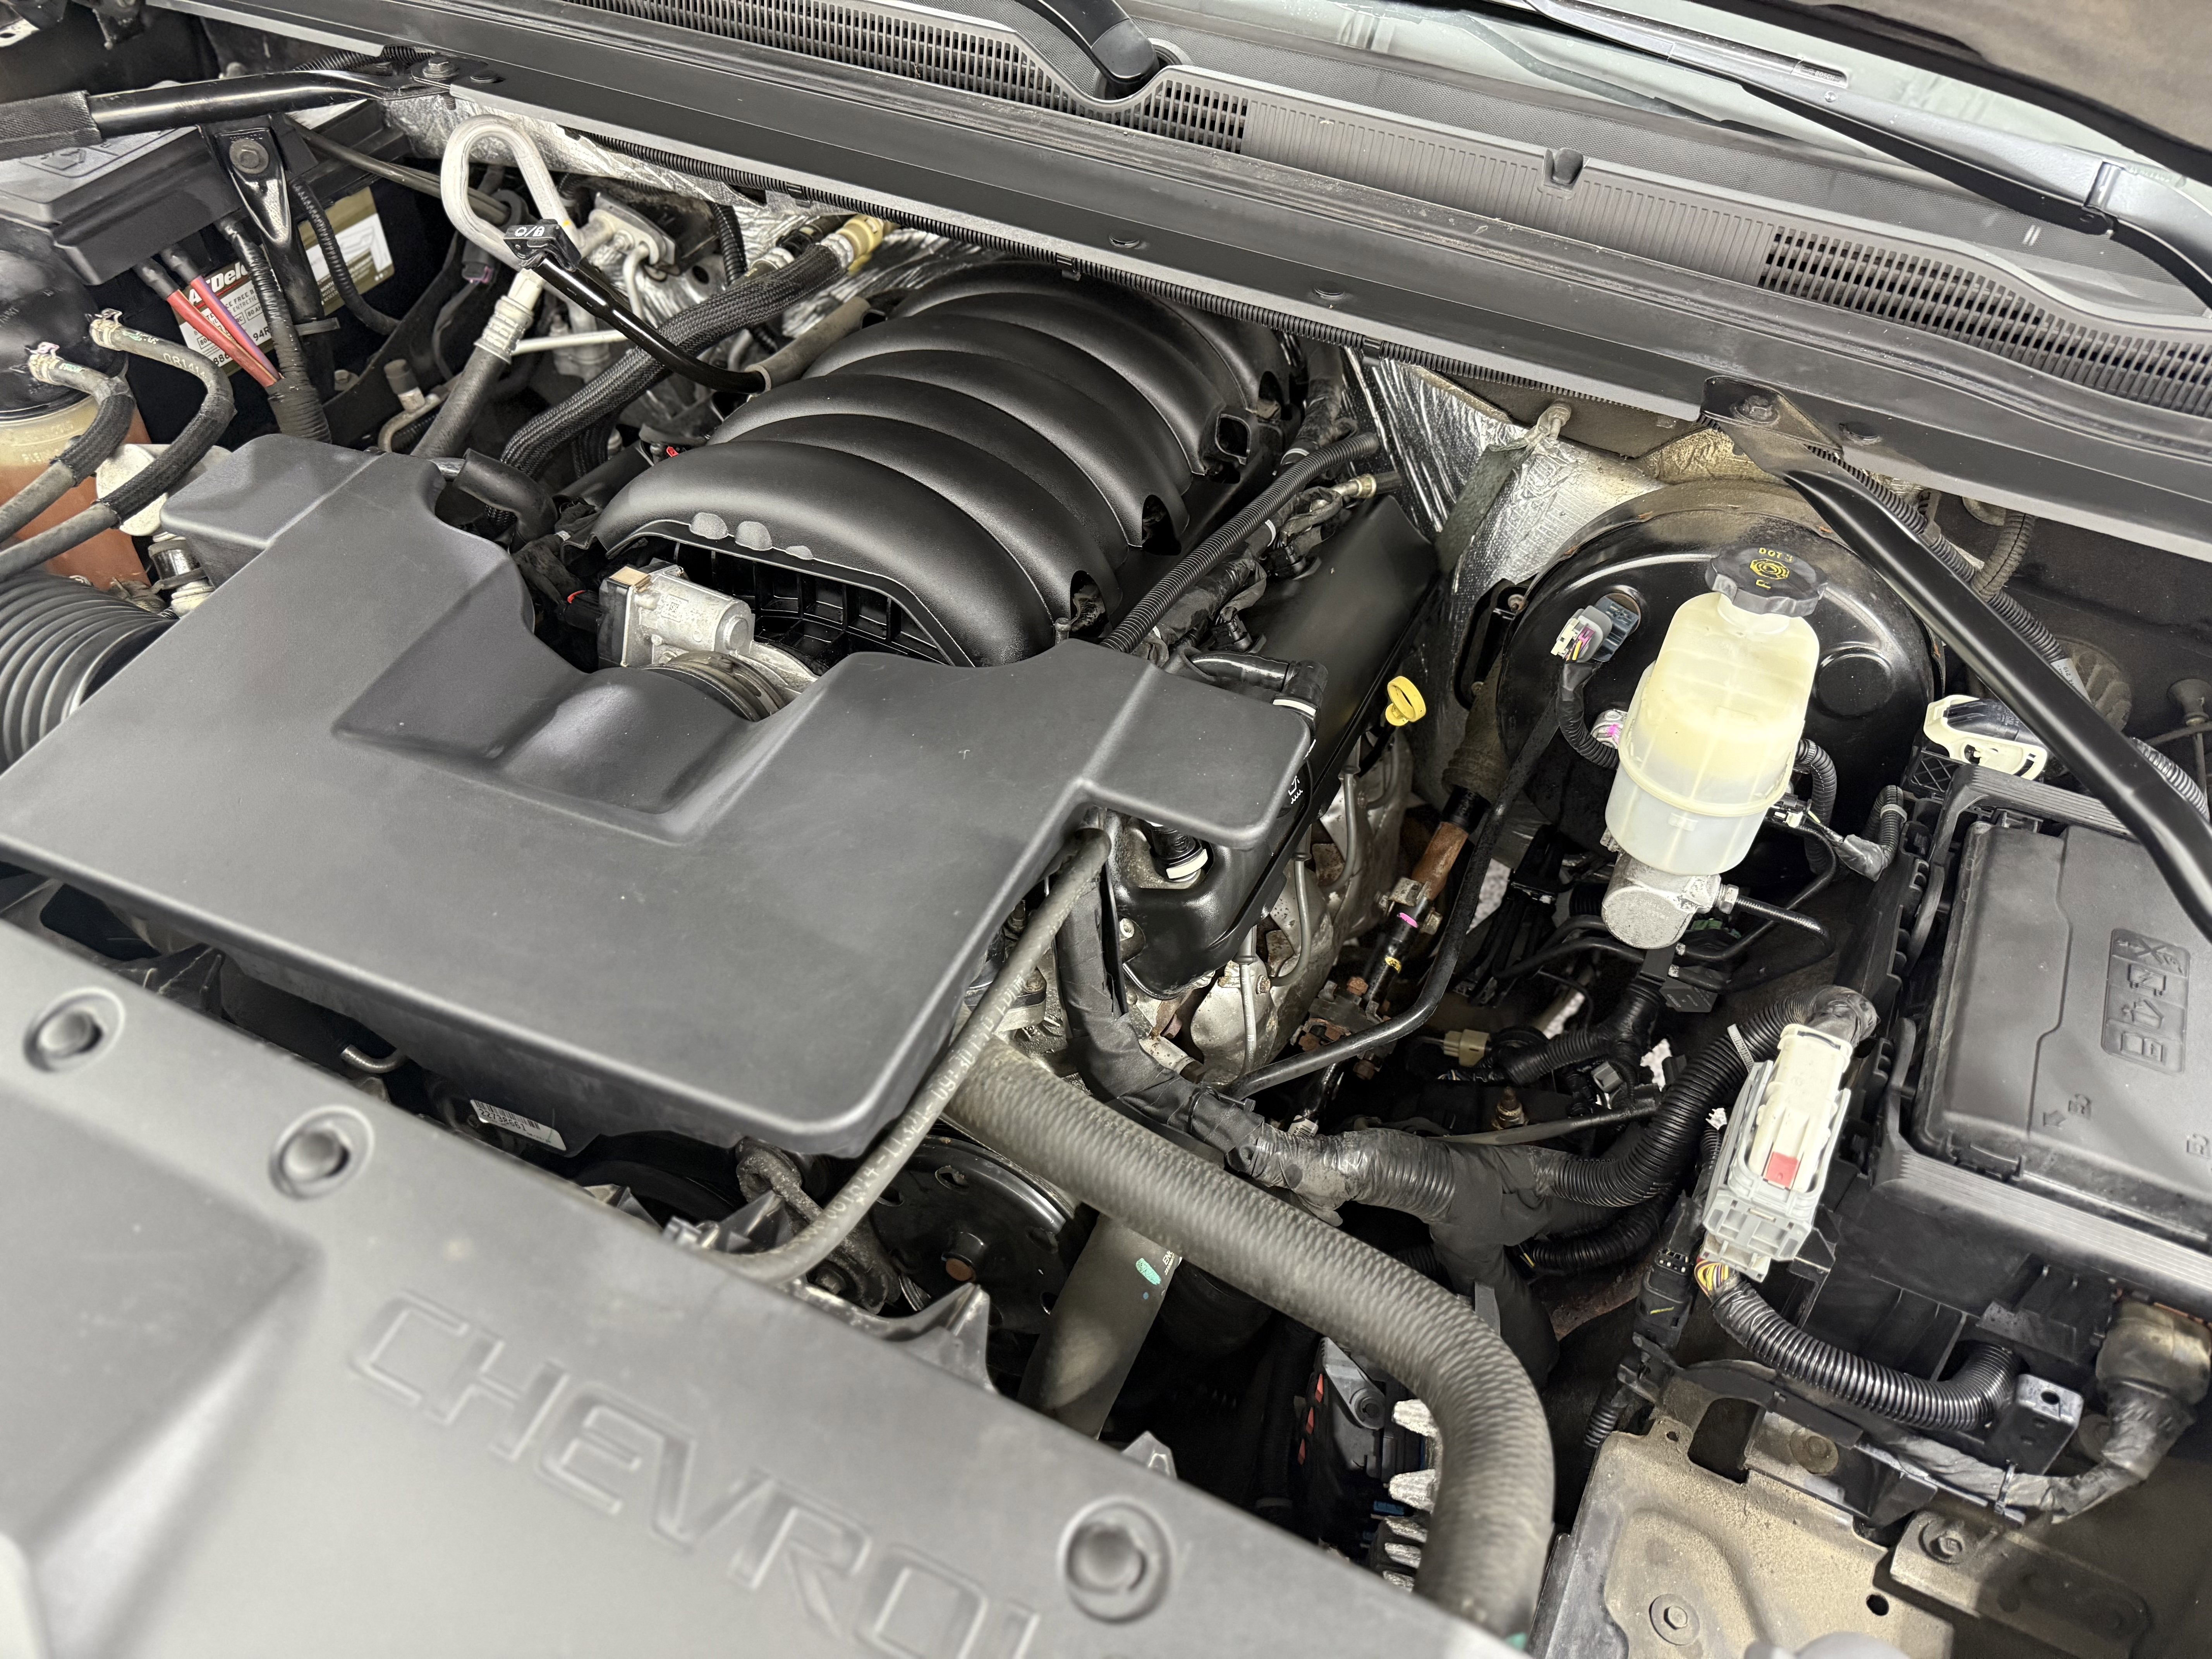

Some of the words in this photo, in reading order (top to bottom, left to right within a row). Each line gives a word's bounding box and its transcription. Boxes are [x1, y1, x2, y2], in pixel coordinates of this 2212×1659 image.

[1815, 70, 1835, 81] BOSCH
[189, 262, 248, 304] ADel
[233, 296, 257, 312] ENTRETIE
[234, 292, 249, 304] FREE
[1759, 548, 1783, 558] DOT
